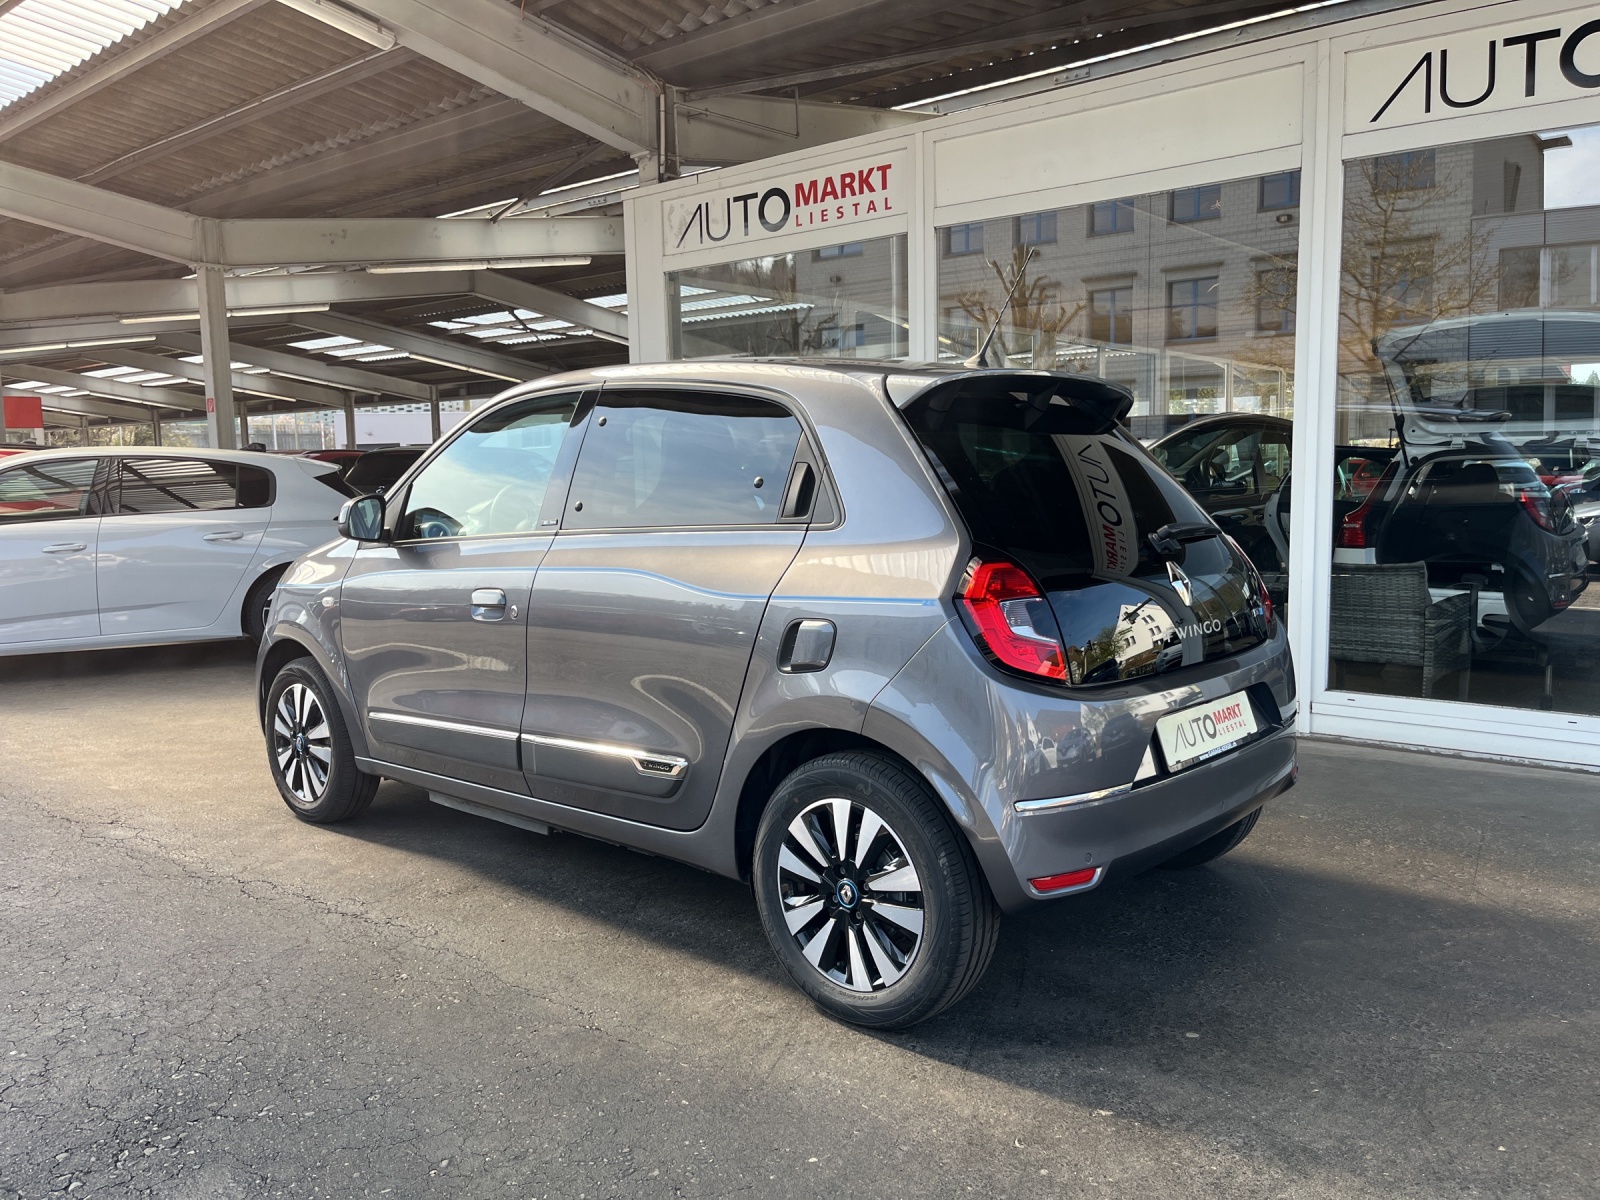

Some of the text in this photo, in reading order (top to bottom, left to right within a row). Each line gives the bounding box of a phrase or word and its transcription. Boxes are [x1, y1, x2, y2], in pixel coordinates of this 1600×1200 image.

[676, 164, 892, 248] AUTO MARKT
[795, 197, 892, 227] LIESTAL
[1175, 713, 1217, 753] AUTO
[1213, 703, 1243, 725] MARKT
[1218, 720, 1246, 736] LIESTAL
